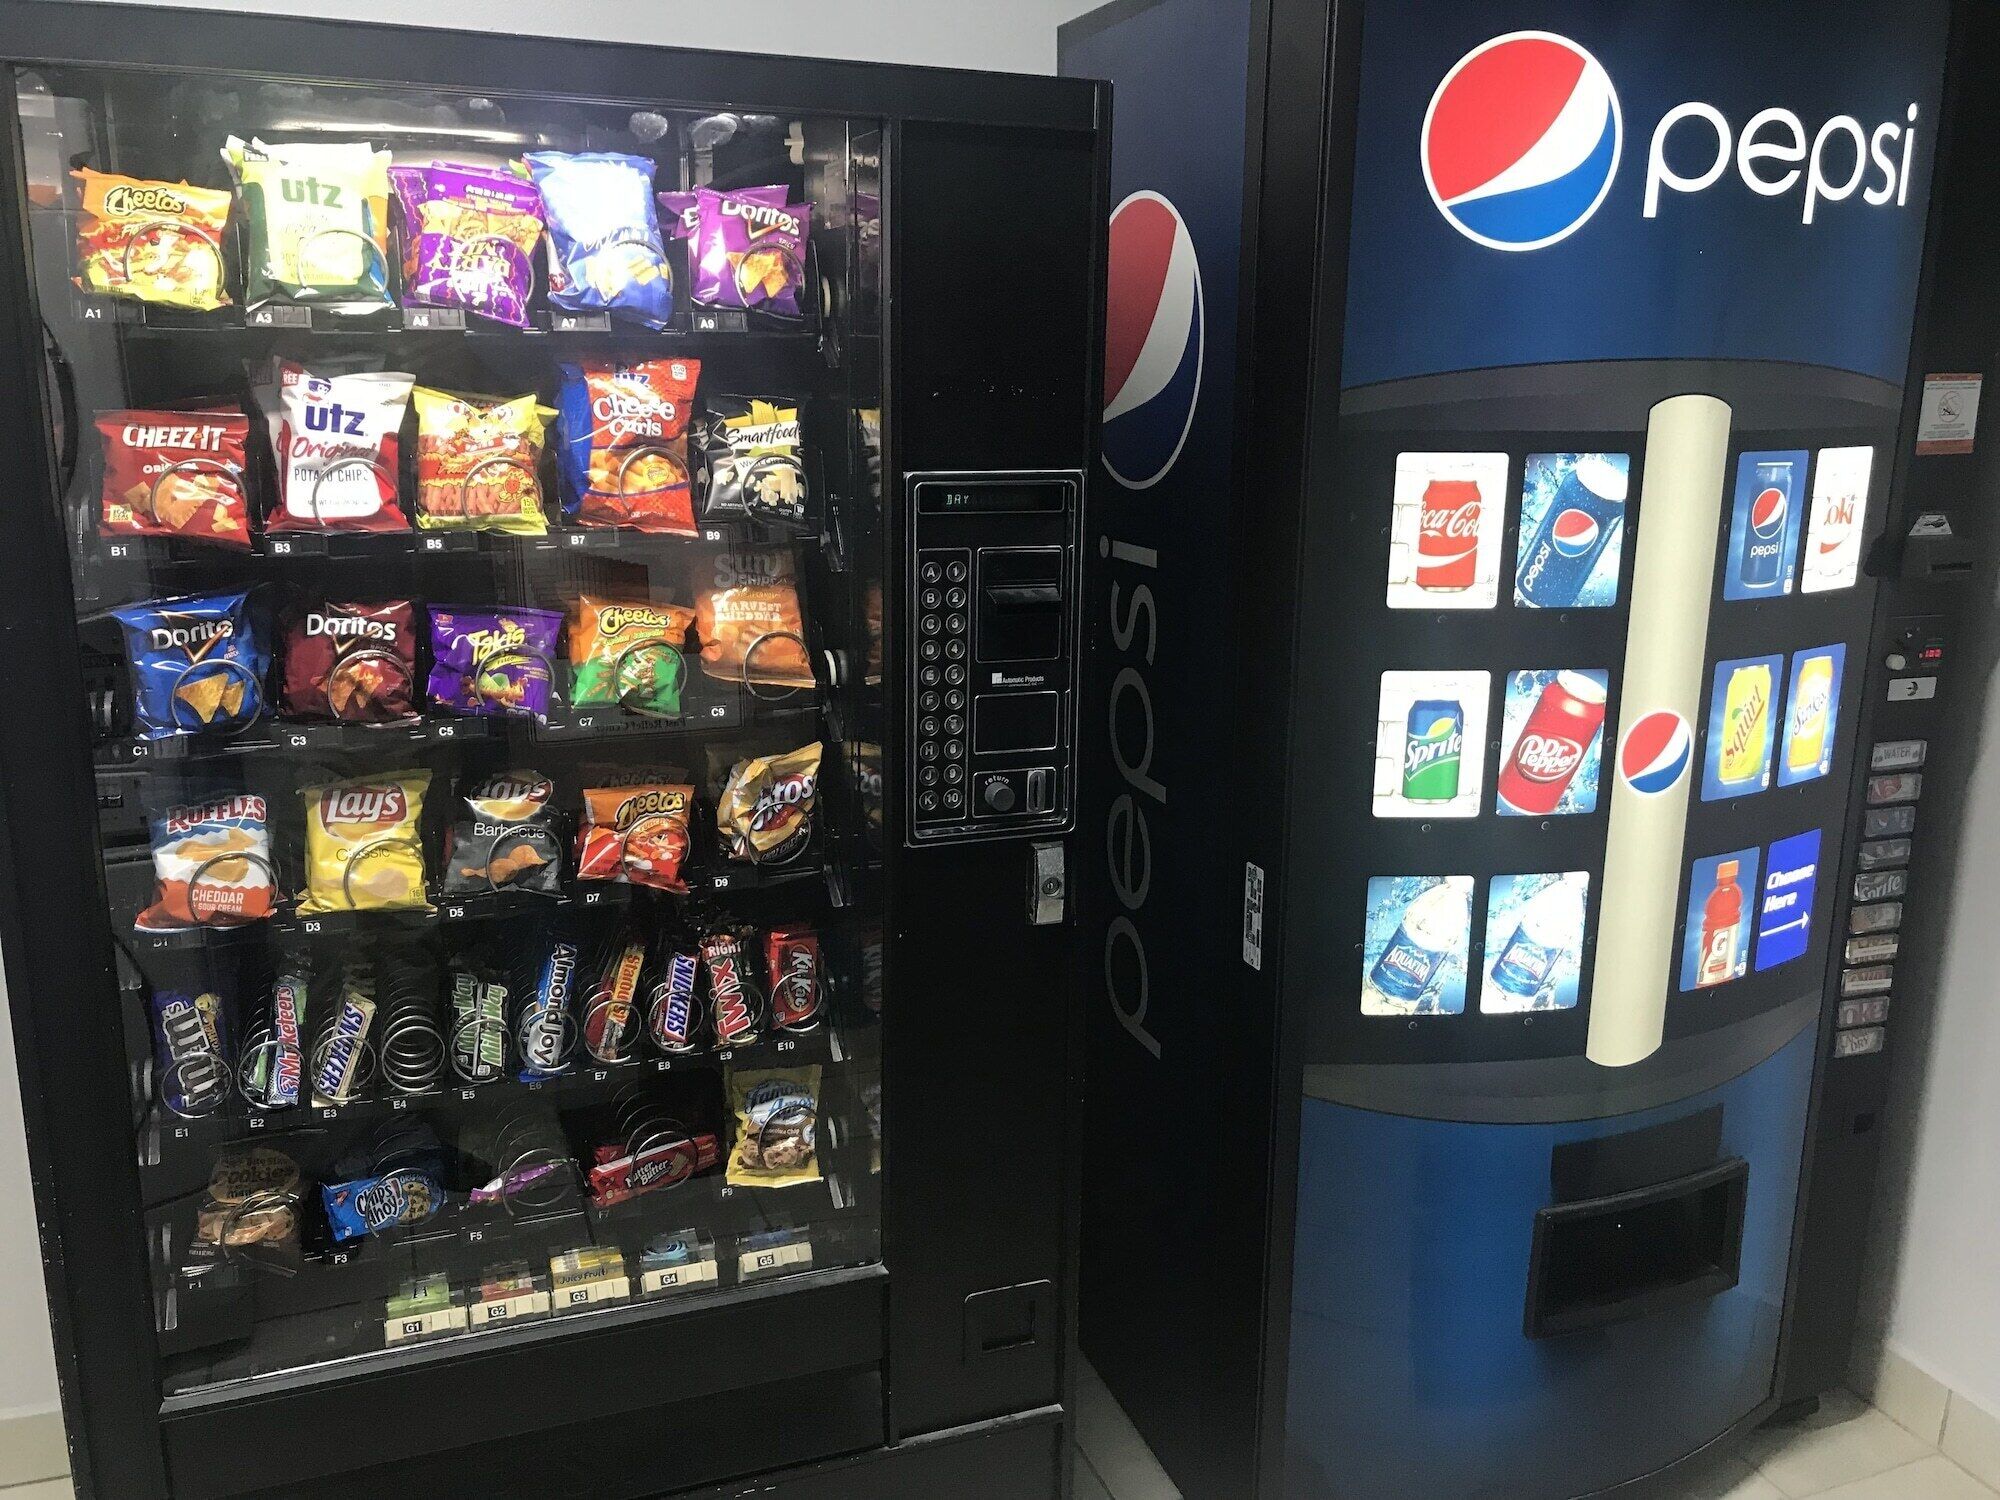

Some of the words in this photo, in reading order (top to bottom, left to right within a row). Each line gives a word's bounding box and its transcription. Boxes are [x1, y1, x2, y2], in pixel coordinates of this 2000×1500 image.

[1643, 101, 1919, 224] pepsi
[281, 176, 343, 208] utz
[105, 186, 186, 216] Cheetos
[722, 200, 801, 236] Doritos
[85, 308, 101, 319] A1
[255, 312, 272, 323] A3
[561, 318, 576, 328] A7
[700, 319, 715, 328] A9
[282, 373, 298, 385] REE
[593, 393, 676, 421] Cheese
[305, 403, 366, 437] utz
[609, 417, 663, 437] Curls
[727, 422, 799, 445] Smartfood
[292, 437, 377, 460] Original
[1420, 501, 1482, 538] oca-Col
[570, 535, 585, 545] B7
[706, 531, 720, 540] B9
[274, 542, 291, 553] B3
[426, 539, 443, 550] B5
[1750, 542, 1778, 559] pepsi
[110, 546, 127, 557] B1
[1523, 541, 1552, 592] pepsi
[306, 613, 397, 641] Doritos
[599, 606, 670, 637] Cheetos
[151, 619, 234, 650] Dorito
[467, 628, 526, 665] Takis
[711, 707, 724, 717] C9
[579, 717, 593, 727] C7
[438, 727, 454, 736] C5
[291, 736, 306, 746] C3
[133, 746, 148, 756] C1
[1404, 732, 1462, 774] Sprite
[1519, 735, 1577, 773] Pepper
[984, 775, 1010, 786] return
[1100, 535, 1167, 1060] pepsi
[327, 788, 401, 823] Lay's
[616, 791, 686, 831] Cheetos
[166, 794, 267, 834] RUFFLES
[336, 846, 391, 863] Cssic
[714, 878, 729, 887] D9
[1766, 864, 1815, 890] Choose
[192, 889, 245, 904] CHEDDAR
[586, 893, 600, 903] D7
[1763, 892, 1798, 913] Here
[198, 903, 216, 912] SOUR
[217, 904, 242, 913] CREAM
[449, 908, 464, 917] D5
[306, 923, 321, 933] D3
[708, 941, 741, 957] RIGHT
[545, 943, 577, 1025] Almond
[607, 955, 640, 1022] Starbust
[481, 983, 508, 1019] Way
[667, 953, 696, 1037] SNICKERS
[276, 986, 301, 1076] Muketeers
[320, 1002, 365, 1097] SNICKERS
[533, 1023, 564, 1065] Joy
[777, 1041, 795, 1051] E10
[720, 1051, 732, 1060] E9
[658, 1061, 671, 1071] E8
[595, 1071, 607, 1080] E7
[462, 1090, 475, 1100] E5
[393, 1100, 406, 1109] E4
[323, 1109, 337, 1119] E3
[250, 1118, 265, 1128] E2
[175, 1128, 189, 1138] E1
[625, 1161, 655, 1188] Nutter
[640, 1160, 669, 1186] Butter
[721, 1188, 733, 1197] F9
[355, 1184, 394, 1216] Chips
[470, 1231, 483, 1241] F5
[334, 1254, 348, 1264] F3
[759, 1256, 773, 1266] G5
[662, 1273, 676, 1284] G4
[572, 1292, 586, 1302] G3
[491, 1306, 505, 1316] G2
[405, 1323, 420, 1333] G1
